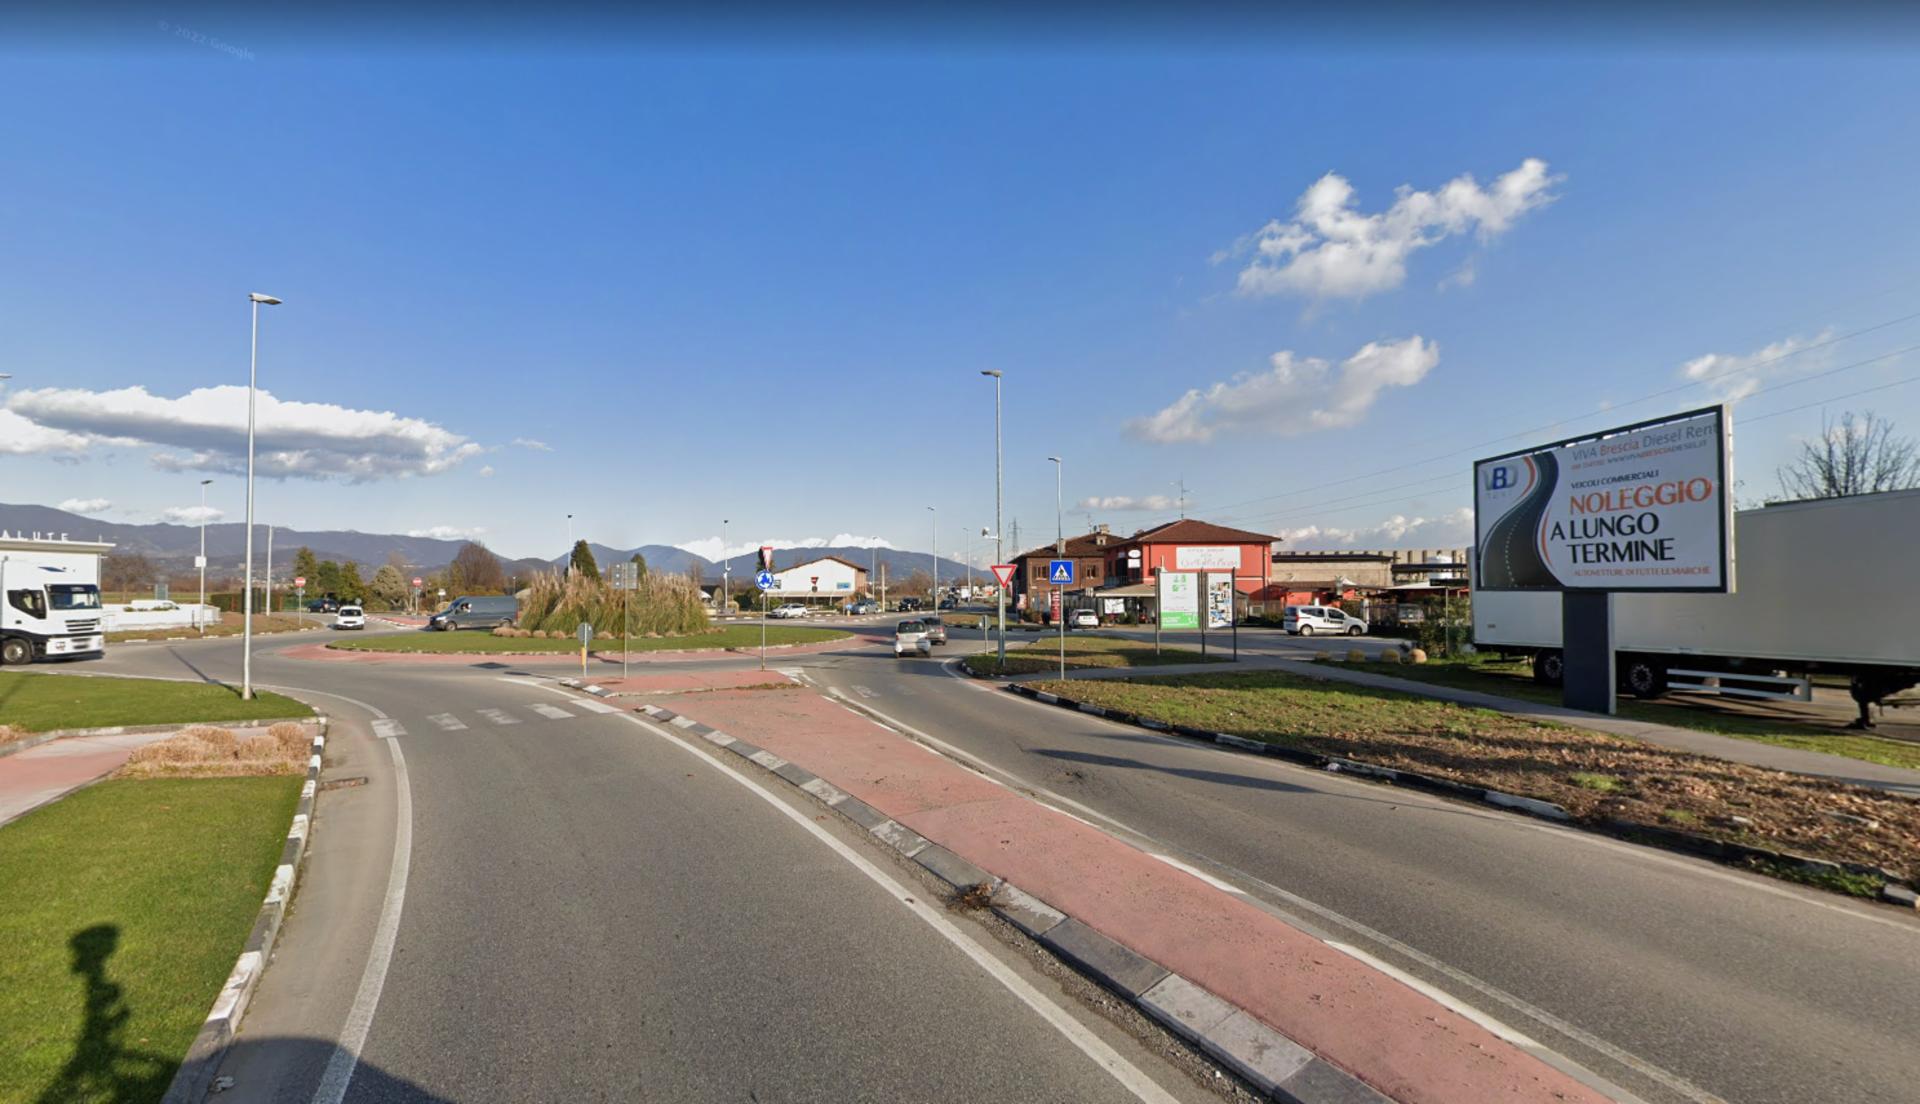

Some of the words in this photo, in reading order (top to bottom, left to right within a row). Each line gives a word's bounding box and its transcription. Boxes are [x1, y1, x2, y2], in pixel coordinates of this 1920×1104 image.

[1572, 448, 1597, 461] VIVA
[1600, 440, 1639, 456] Brescia
[1643, 430, 1682, 448] Diesel
[1571, 479, 1600, 489] VEICOLI
[1601, 469, 1659, 485] COMMERCIALI
[1570, 477, 1713, 515] NOLEGGIO
[1550, 521, 1565, 541] A
[1570, 512, 1660, 540] LUNGO
[1566, 538, 1675, 564] TERMINE
